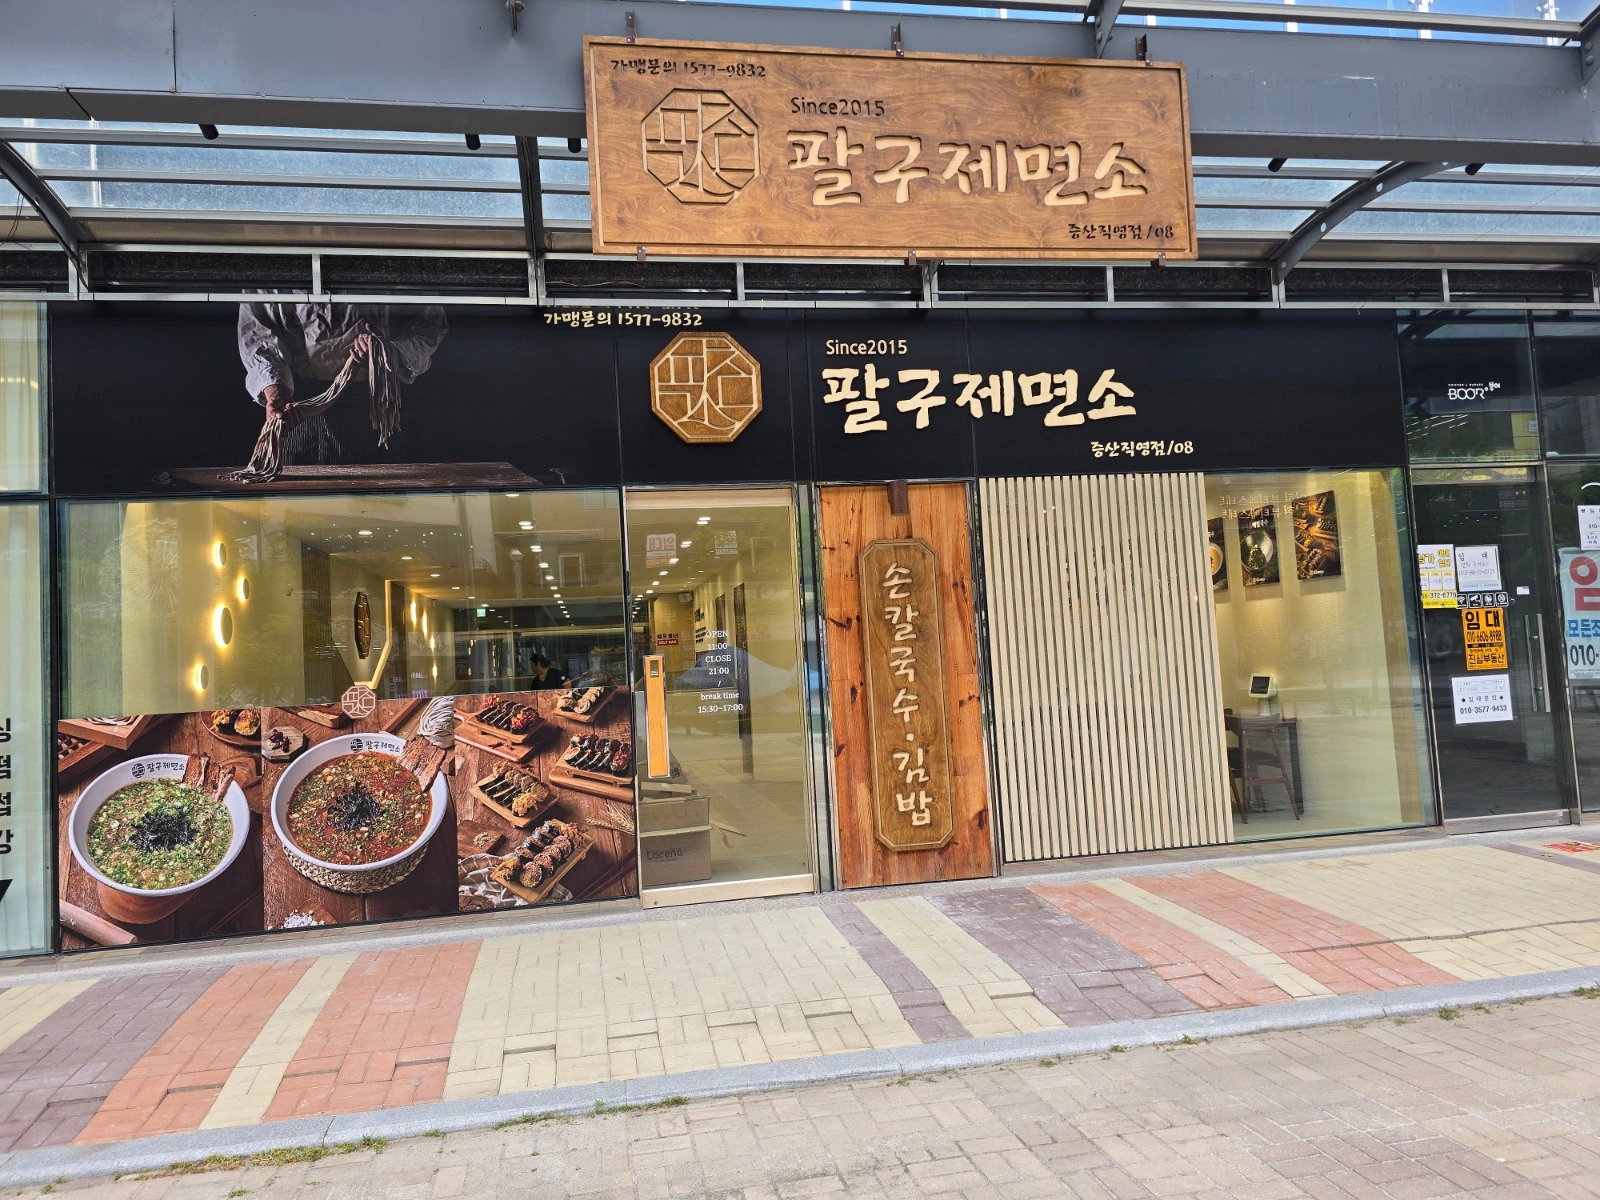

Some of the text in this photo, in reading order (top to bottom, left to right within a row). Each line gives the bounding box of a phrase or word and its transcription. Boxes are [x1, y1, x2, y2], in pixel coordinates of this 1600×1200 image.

[611, 59, 766, 78] 가맹문의 1577-9832
[790, 96, 885, 118] Since2015
[786, 126, 1149, 206] 팔구제면소
[543, 310, 703, 328] 가맹문의 1577-9832
[825, 339, 908, 356] Since2015
[821, 363, 1137, 434] 팔구제면소
[1091, 440, 1194, 458] 증산직영점/08
[706, 630, 729, 638] OPEN
[707, 642, 728, 650] 11:00
[705, 654, 732, 663] CLOSE
[708, 667, 730, 675] 21:00
[700, 691, 740, 700] break time
[698, 703, 744, 713] 15:30~17:00
[1460, 705, 1508, 714] 010-3577-9433
[146, 762, 185, 772] 팔구제면소
